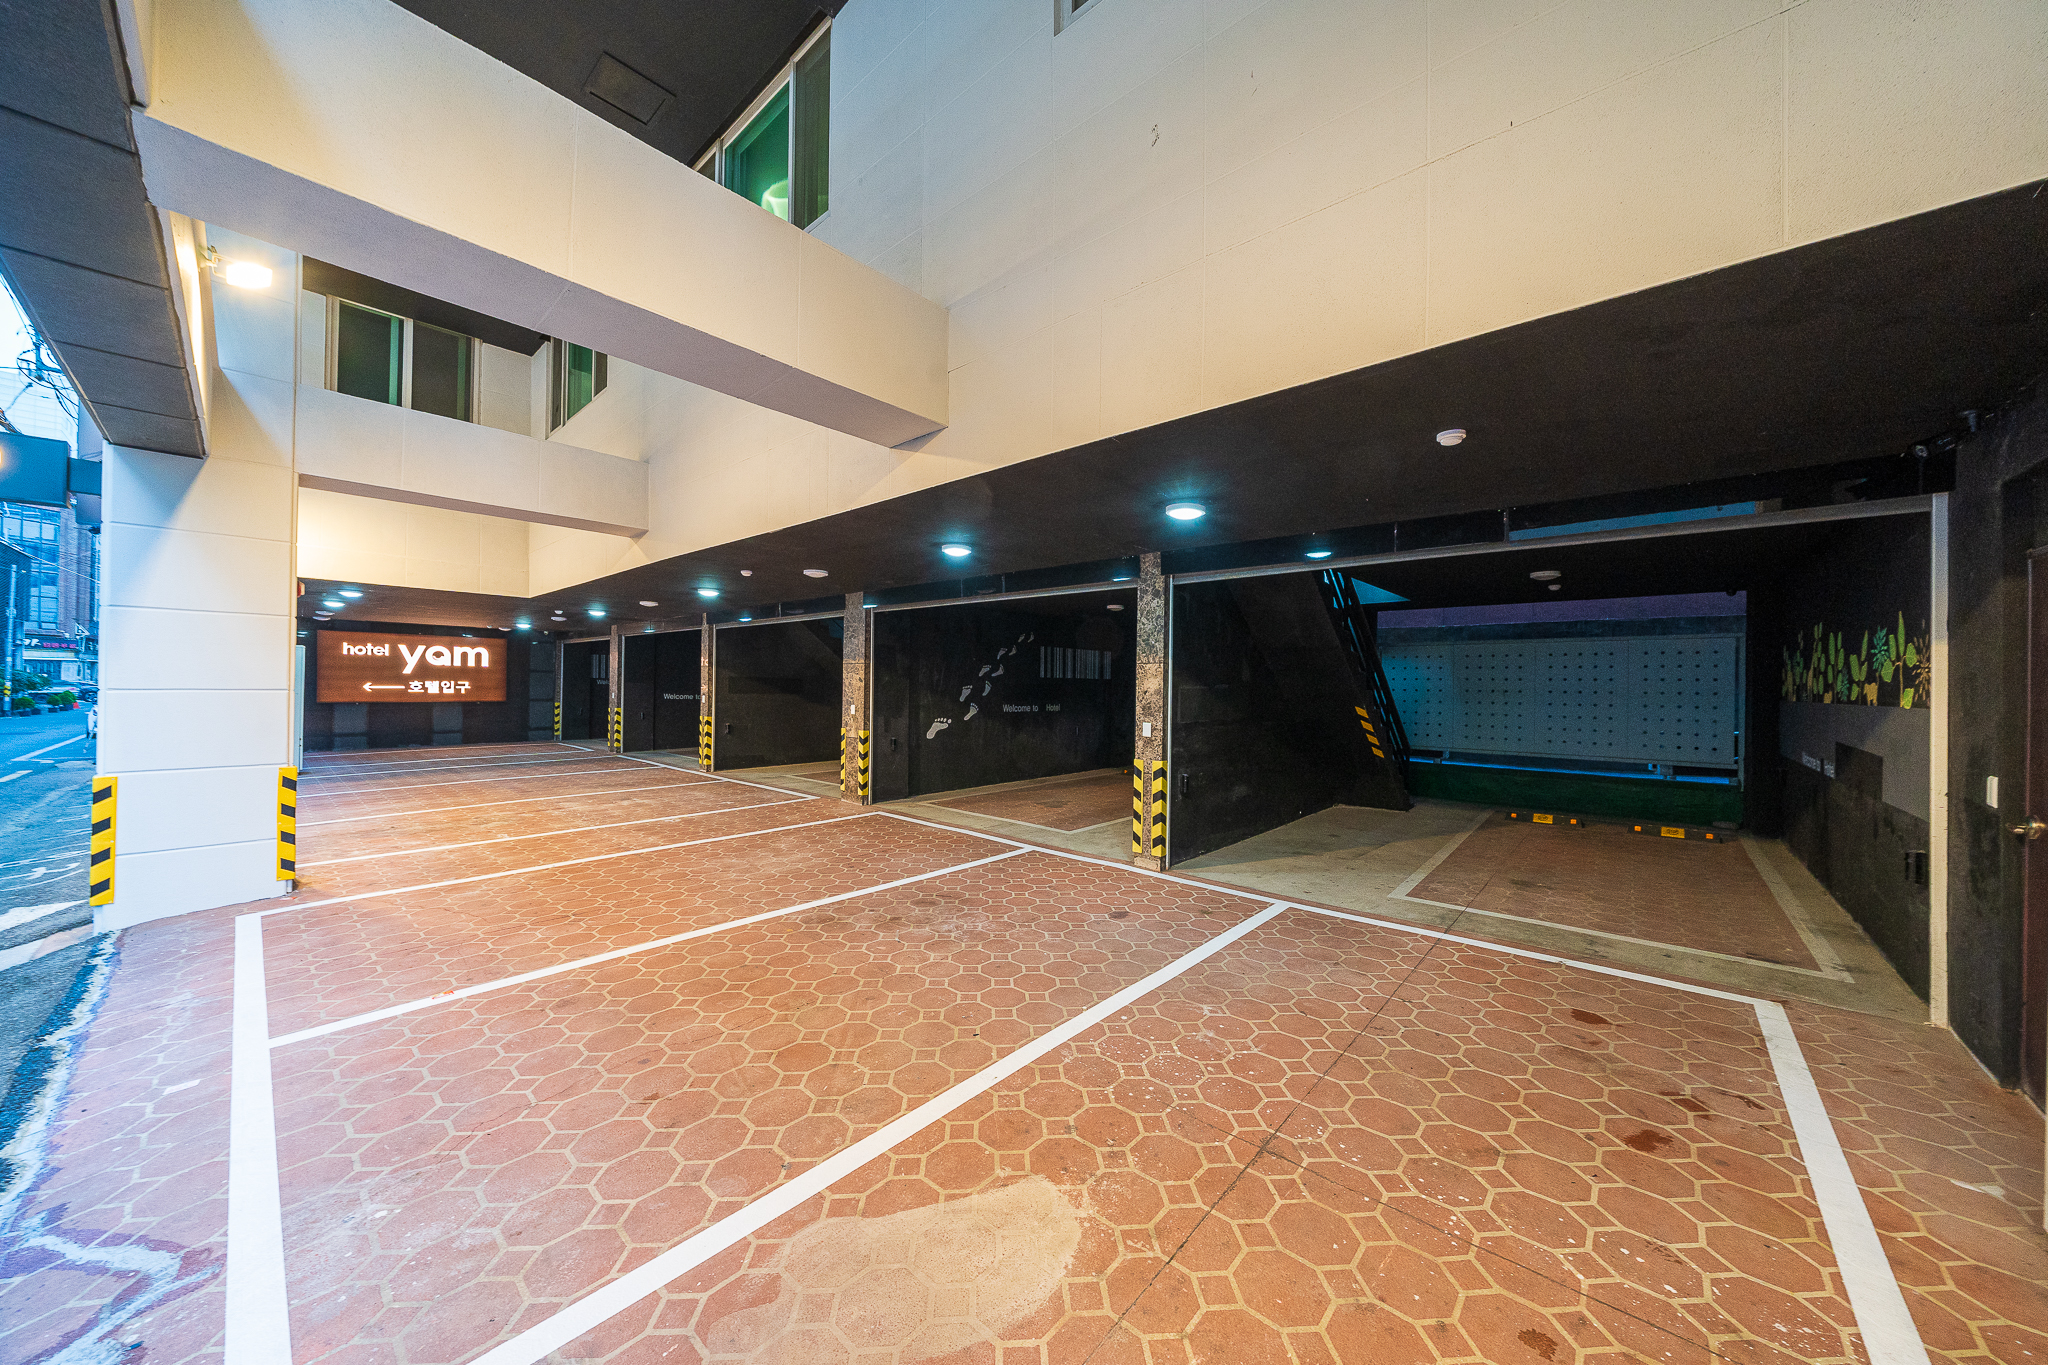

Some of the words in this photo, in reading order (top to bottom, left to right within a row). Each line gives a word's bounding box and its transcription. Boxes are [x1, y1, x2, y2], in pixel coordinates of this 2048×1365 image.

[342, 642, 390, 656] hotel
[398, 644, 489, 674] yam
[407, 680, 472, 694] 호텔입구
[1002, 704, 1031, 712] Welcome
[1032, 704, 1039, 712] to
[1045, 703, 1061, 712] Hotel
